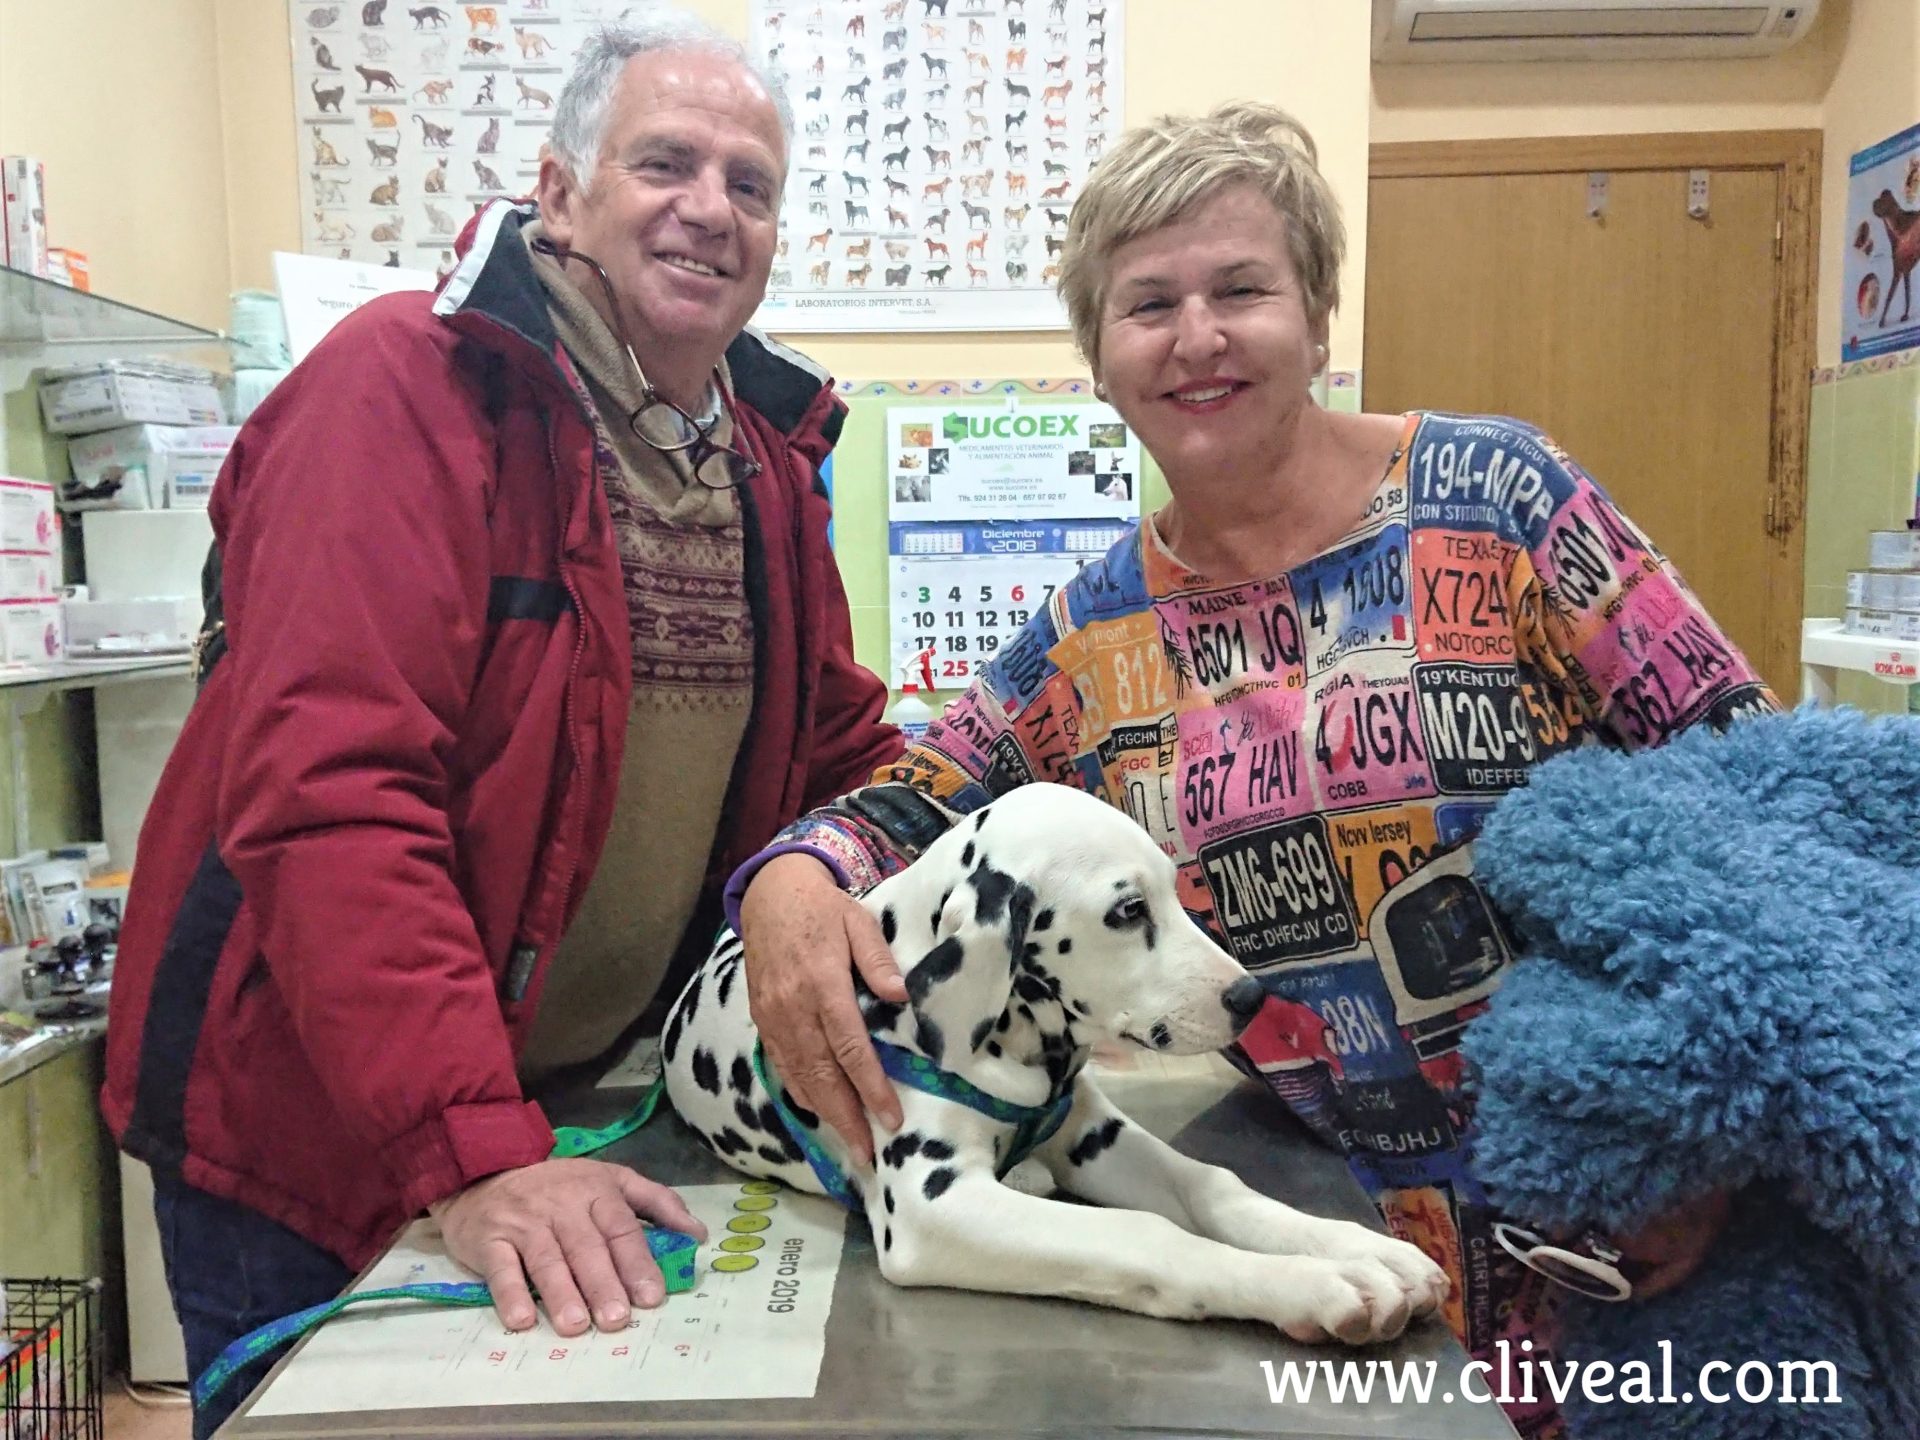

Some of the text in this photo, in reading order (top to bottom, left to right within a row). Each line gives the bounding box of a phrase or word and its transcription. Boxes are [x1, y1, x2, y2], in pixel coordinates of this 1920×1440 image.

[795, 299, 866, 308] LABORATORIOS
[943, 411, 1080, 444] SUCOEX
[982, 528, 1045, 539] Diciembre
[991, 540, 1037, 552] 2018
[918, 585, 1056, 603] 3 4 5 6 7
[1188, 591, 1247, 616] MAINE
[1420, 567, 1509, 628] X724
[912, 610, 1030, 628] 10 11 12 13
[914, 635, 999, 652] 17 18 19
[1258, 603, 1304, 673] JQ
[943, 660, 969, 677] 25
[1112, 642, 1168, 715] 812
[1118, 730, 1158, 747] FGCHN
[1161, 724, 1178, 739] THE
[1184, 752, 1237, 828] 567
[1248, 729, 1298, 807] HAV
[1327, 780, 1368, 801] COBB
[1207, 831, 1336, 929] ZM6-699
[1233, 930, 1262, 954] FHC
[1324, 912, 1349, 935] CD
[766, 1237, 805, 1314] enero 2019
[487, 1350, 507, 1362] 27
[548, 1348, 569, 1361] 20
[611, 1345, 629, 1357] 13
